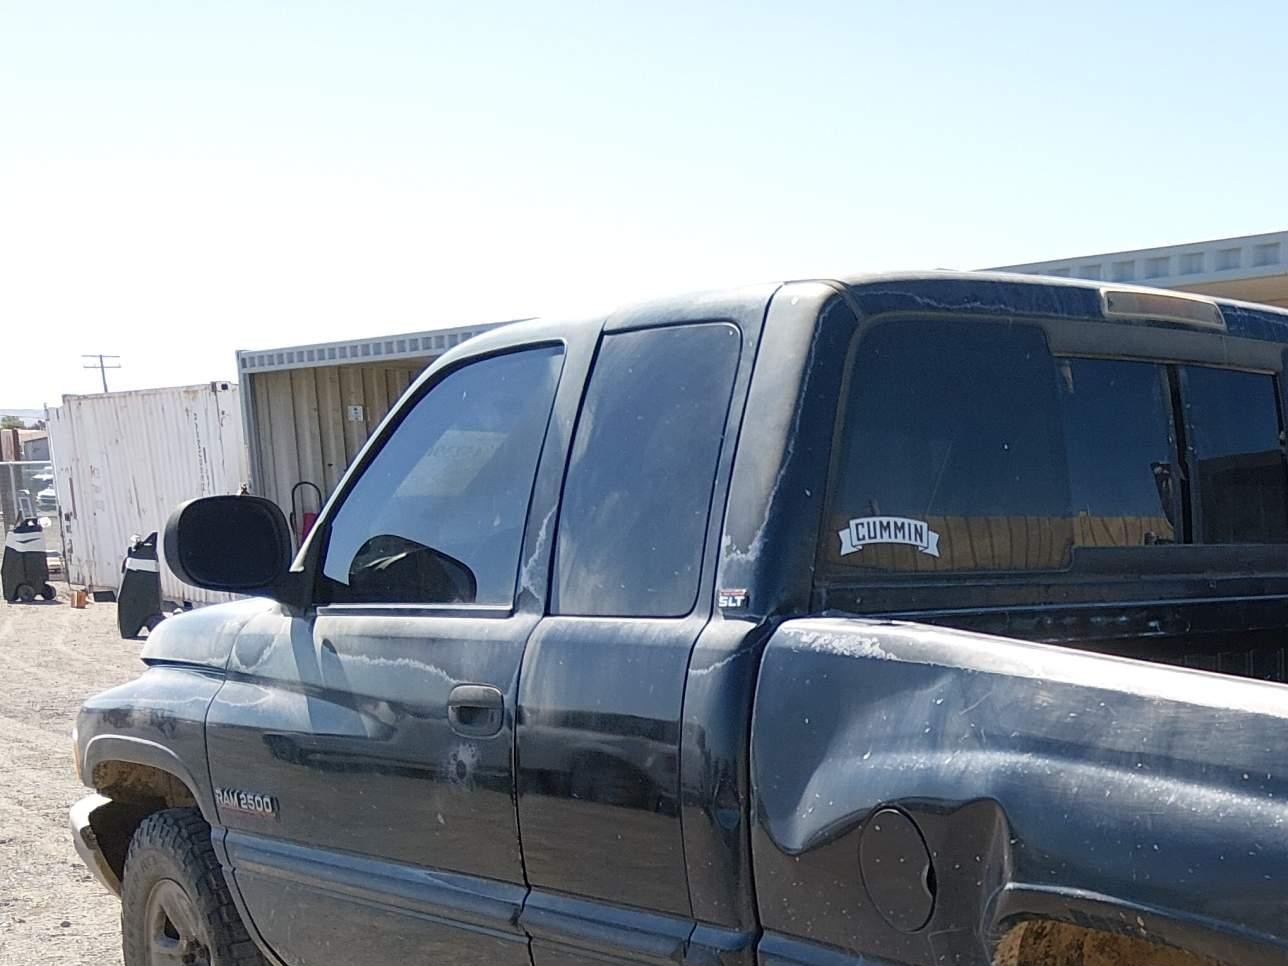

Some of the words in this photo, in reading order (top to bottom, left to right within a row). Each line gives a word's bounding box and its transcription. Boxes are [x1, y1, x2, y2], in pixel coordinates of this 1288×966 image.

[855, 520, 924, 544] CUMMIN
[719, 595, 745, 607] SLT
[215, 789, 240, 809] RAM
[240, 792, 273, 813] 2500
